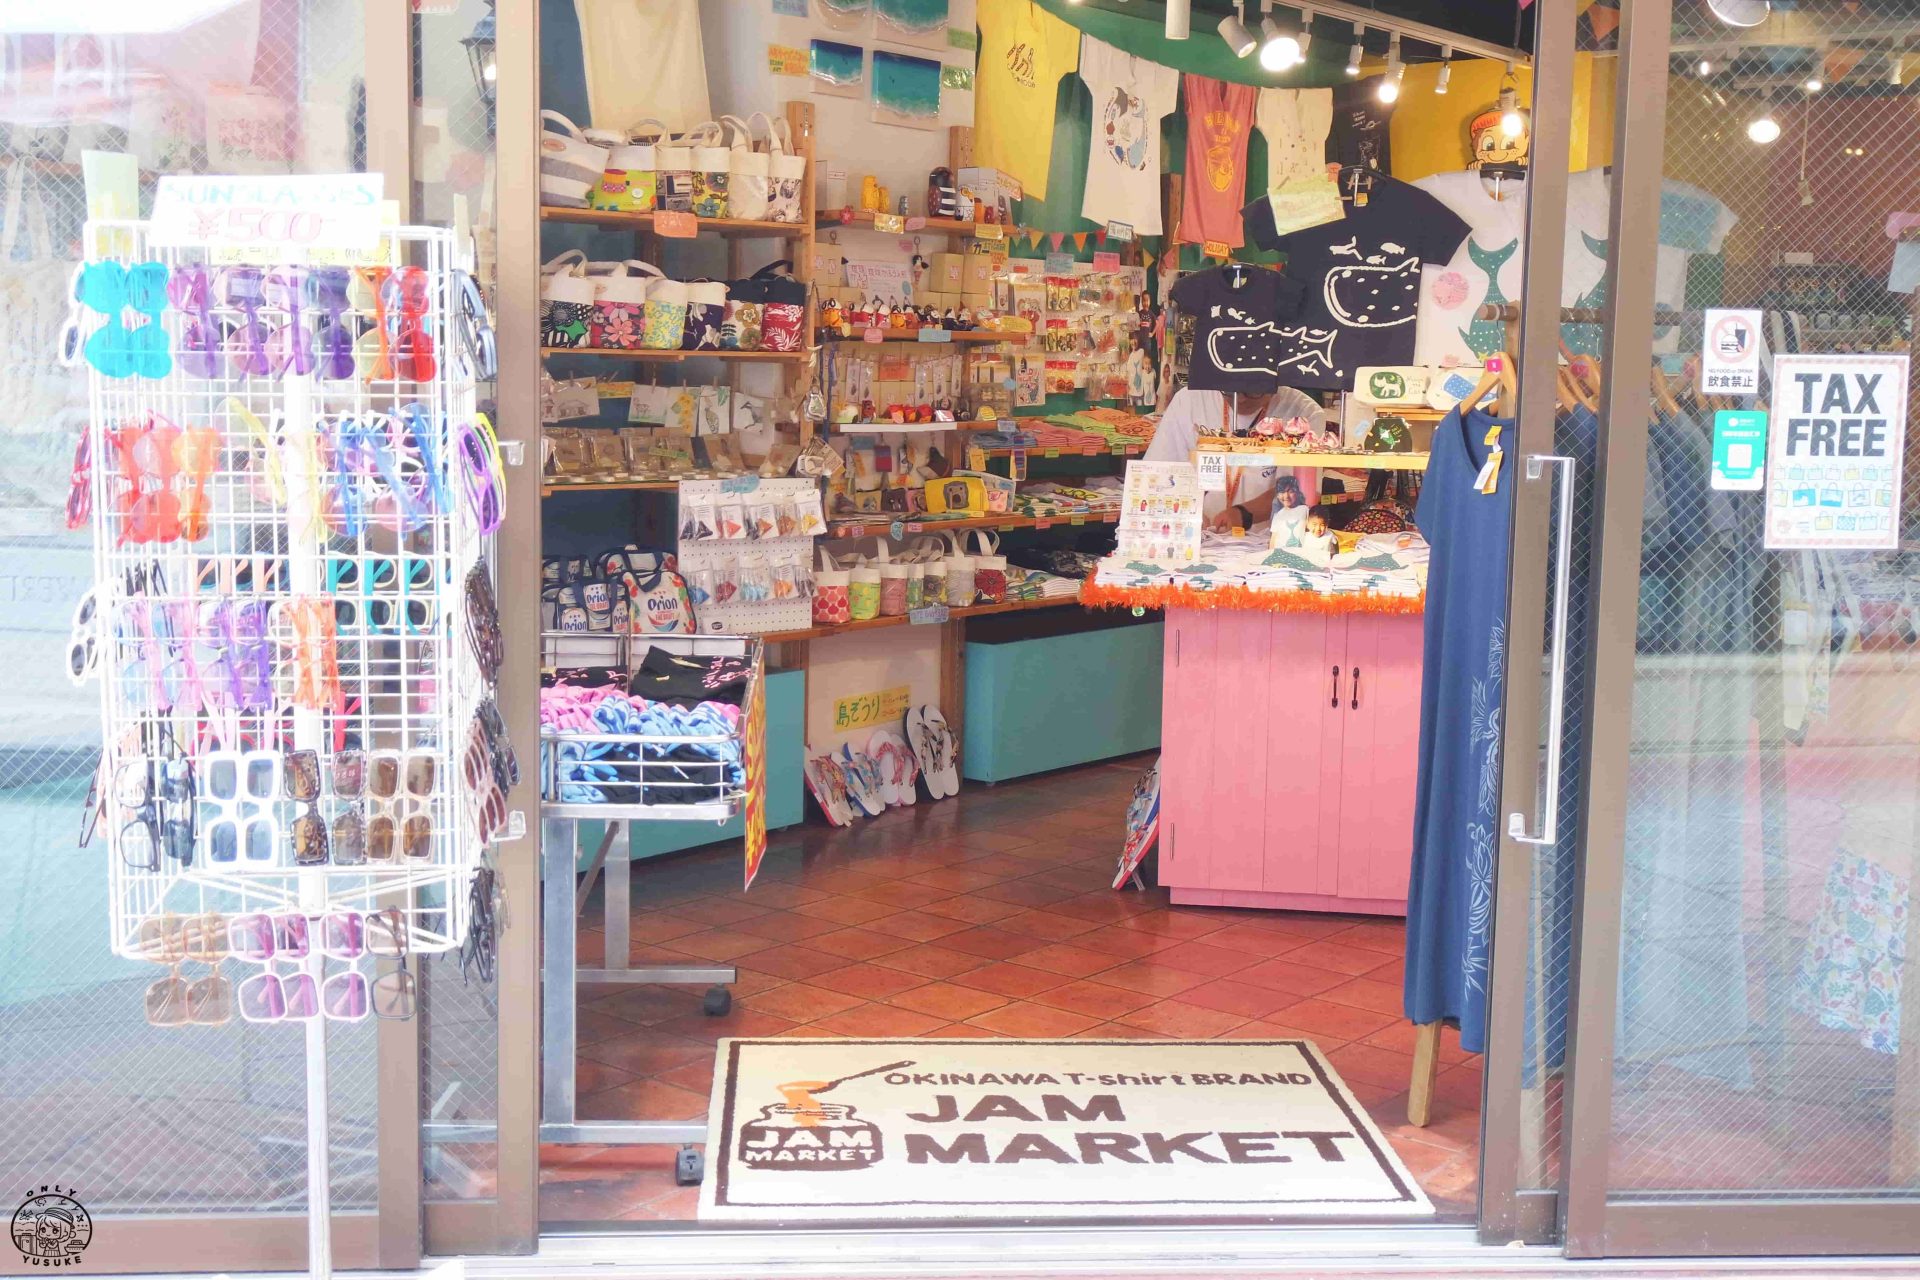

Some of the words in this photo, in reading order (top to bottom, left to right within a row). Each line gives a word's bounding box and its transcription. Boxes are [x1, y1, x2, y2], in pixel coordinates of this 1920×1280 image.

[1708, 375, 1754, 388] 飲食禁止
[1795, 373, 1883, 414] TAX
[1786, 418, 1887, 457] FREE
[1200, 465, 1223, 473] FREE
[1202, 456, 1221, 465] TAX
[647, 595, 679, 611] Orion
[836, 695, 880, 728] 島ぞうり
[885, 1073, 1060, 1086] OKINAWA
[1062, 1073, 1187, 1086] T-shirt
[1191, 1073, 1313, 1086] BRAND
[906, 1094, 1126, 1123] JAM
[746, 1129, 874, 1149] JAM
[905, 1131, 1355, 1164] MARKET
[745, 1148, 876, 1161] MARKET
